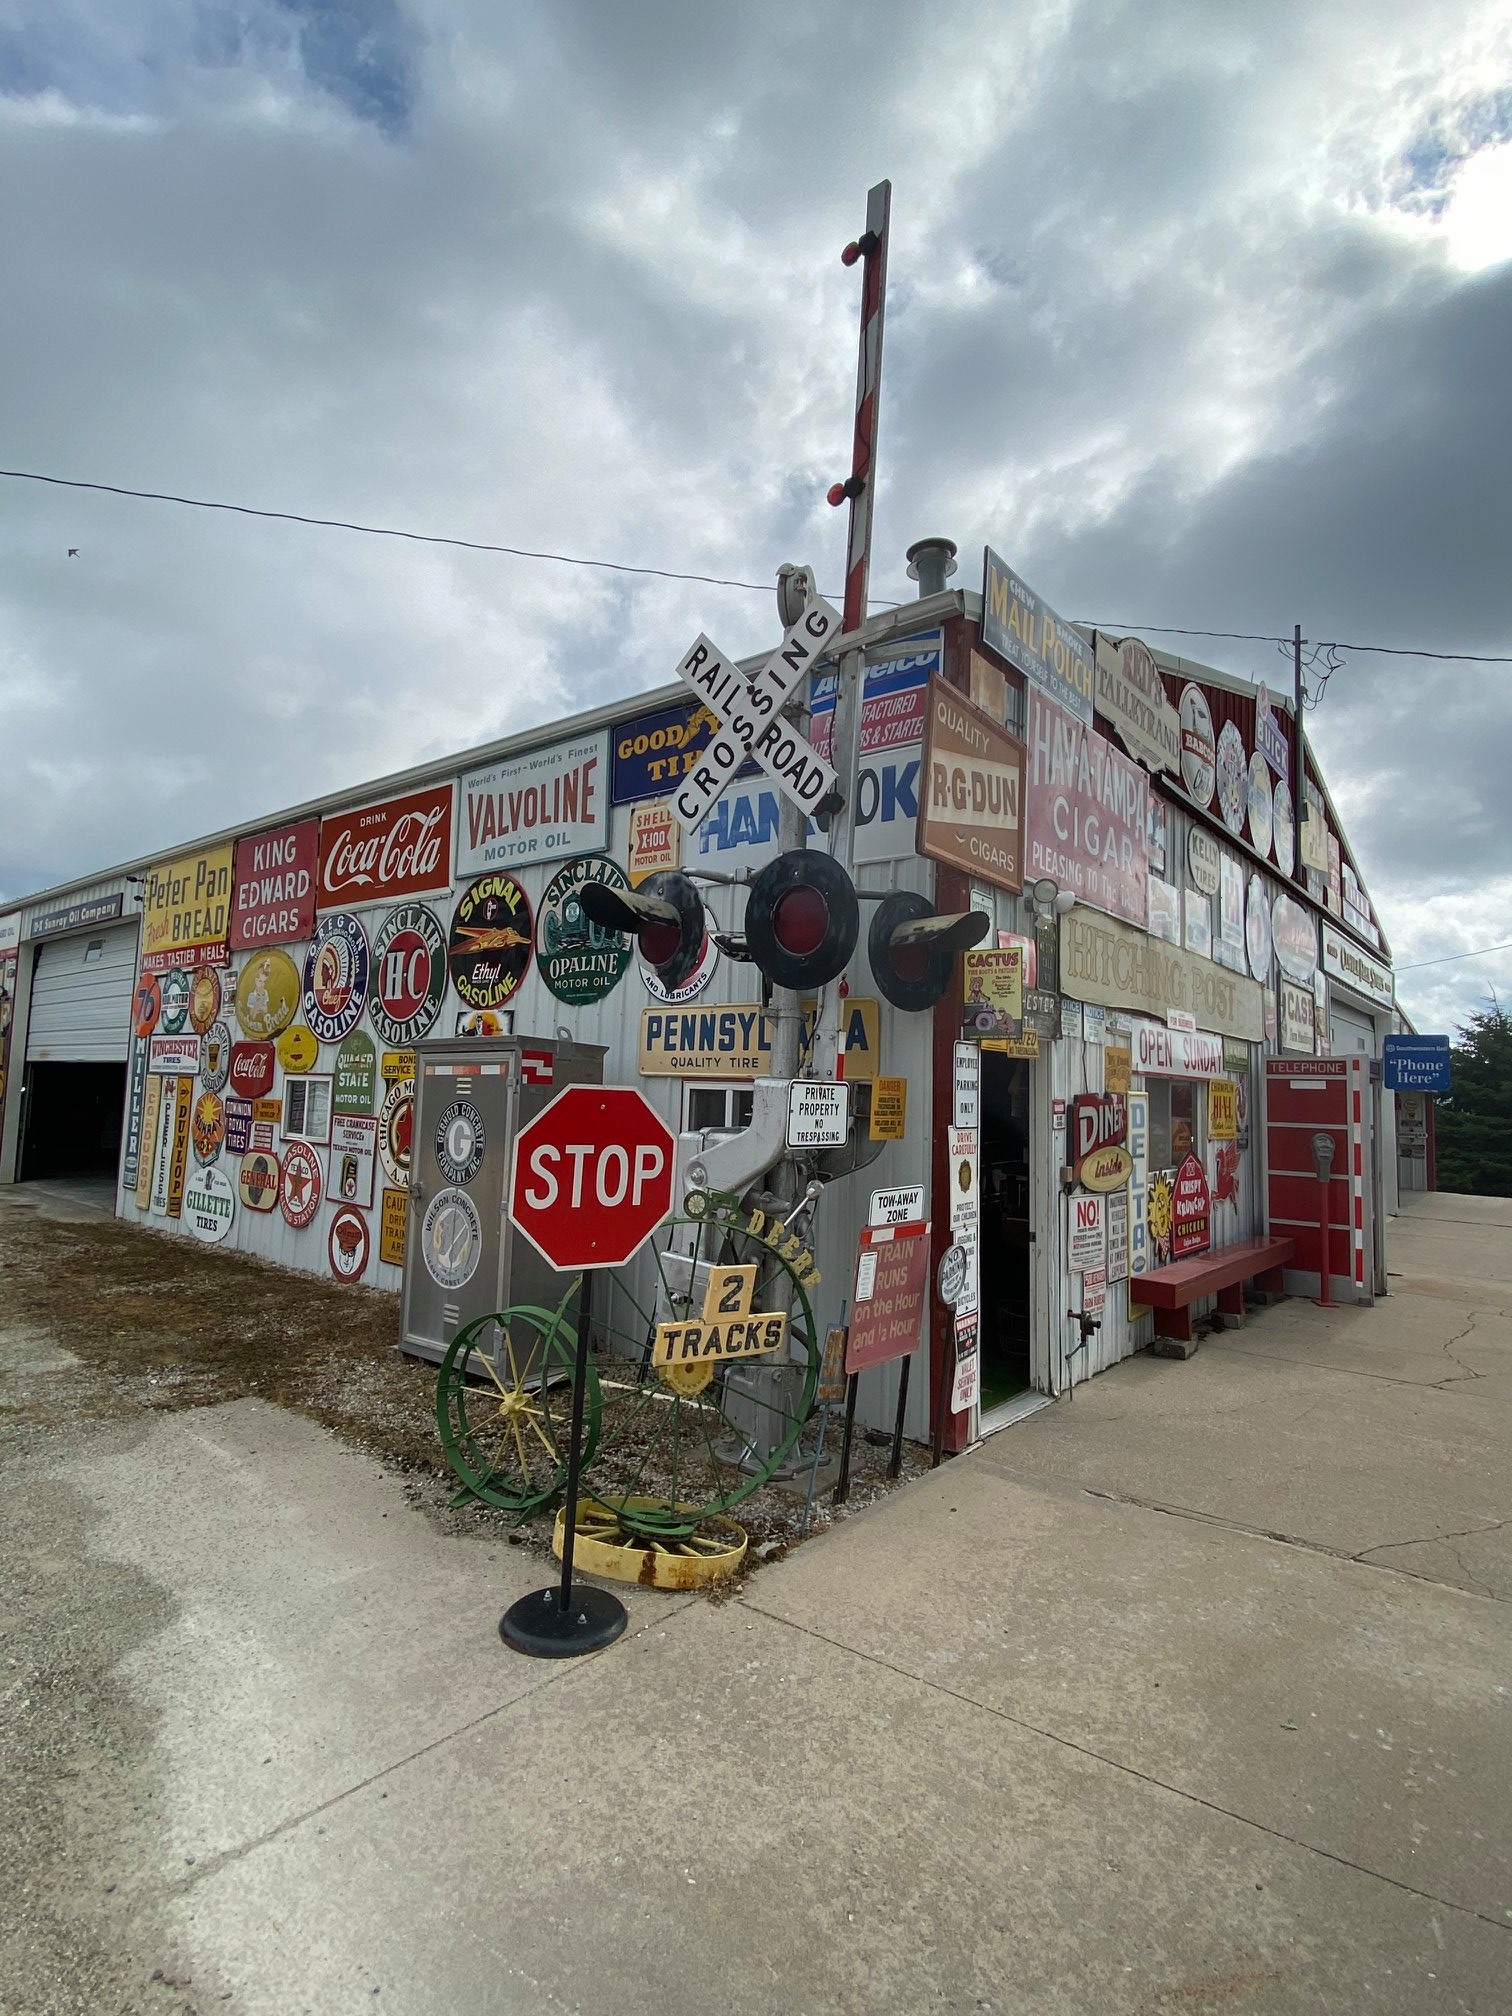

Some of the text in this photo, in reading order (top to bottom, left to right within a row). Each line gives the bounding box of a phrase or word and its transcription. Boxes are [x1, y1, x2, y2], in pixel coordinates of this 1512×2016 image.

[990, 564, 1093, 701] MAIL POUCH
[937, 702, 990, 753] QUALITY
[568, 744, 598, 759] Finest
[1257, 715, 1287, 771] BUICK
[755, 722, 824, 800] ROAD
[467, 757, 598, 850] VALVOLINE
[360, 812, 387, 828] DRINK
[636, 811, 673, 828] SHELL
[324, 802, 448, 892] Coca-Cola
[485, 832, 571, 861] MOTOR OIL
[641, 830, 665, 849] X-100
[1053, 796, 1133, 876] CIGAR
[1192, 832, 1217, 864] KELLY
[253, 835, 296, 872] KING
[634, 853, 672, 866] MOTOR OIL
[969, 836, 1015, 873] CIGARS
[1032, 841, 1082, 884] PLEASING
[148, 860, 227, 911] Peter Pan
[238, 869, 310, 911] EDWARD
[548, 860, 624, 908] SINCLAIR
[1195, 865, 1216, 887] TIRES
[460, 878, 522, 922] SIGNAL
[45, 902, 117, 931] Sunray Oil Company
[146, 905, 224, 946] Fresh BREAD
[243, 908, 299, 939] CIGARS
[310, 915, 366, 957] OREGON
[375, 909, 442, 960] SINCLAIR
[143, 944, 225, 969] MAKES TASTIER MEALS
[550, 952, 619, 979] OPALINE
[967, 952, 1019, 968] CACTUS
[1067, 917, 1236, 1023] HITCHING POST
[457, 971, 518, 1008] GASOLINE
[472, 962, 501, 989] Ethyl
[554, 977, 611, 989] MOTOR OIL
[645, 972, 708, 1001] AND LUBRICANTS
[137, 982, 157, 1021] 76
[305, 989, 363, 1038] GASOLINE
[1085, 1005, 1104, 1020] NOTICE
[370, 994, 438, 1043] GASOLINE
[152, 1039, 198, 1061] WINCHESTER
[163, 1056, 181, 1064] TIRES
[670, 1057, 721, 1068] QUALITY
[1139, 1028, 1173, 1068] OPEN
[1183, 1037, 1223, 1074] SUNDAY
[339, 1072, 369, 1087] STATE
[384, 1066, 411, 1074] SERVICE
[1270, 1062, 1343, 1073] TELEPHONE
[129, 1037, 146, 1154] MILLER
[336, 1094, 371, 1105] MOTOR OIL
[805, 1087, 835, 1100] PRIVATE
[957, 1080, 978, 1092] PARKING
[380, 1086, 401, 1151] CHICAGO
[799, 1103, 840, 1116] PROPERTY
[960, 1102, 974, 1114] ONLY
[228, 1118, 246, 1132] ROYAL
[334, 1117, 375, 1131] FREE CRANKCASE
[461, 1104, 484, 1149] CONCRETE
[797, 1131, 840, 1143] TRESPASSING
[814, 1119, 824, 1129] NO
[957, 1132, 973, 1144] DRIVE
[1079, 1104, 1125, 1158] DINER
[172, 1106, 188, 1194] DUNLOP
[228, 1134, 245, 1149] TIRES
[451, 1120, 471, 1161] G
[952, 1143, 977, 1156] CAREFULLY
[283, 1145, 319, 1178] GASOLINE
[1130, 1103, 1146, 1250] DELTA
[241, 1170, 277, 1190] GENERAL
[524, 1144, 664, 1210] STOP
[186, 1190, 230, 1219] GILLETTE
[294, 1192, 318, 1225] STATION
[878, 1191, 919, 1209] TOW-AWAY
[887, 1207, 908, 1223] ZONE
[1077, 1200, 1100, 1228] NO!
[197, 1216, 218, 1232] TIRES
[425, 1195, 479, 1241] WILSON CONCRETE
[746, 1208, 822, 1290] DEERE
[876, 1240, 915, 1263] TRAIN
[876, 1265, 908, 1290] RUNS
[718, 1274, 745, 1313] 2
[855, 1291, 920, 1323] on the Hour
[663, 1320, 782, 1360] TRACKS
[853, 1317, 915, 1350] and Hour
